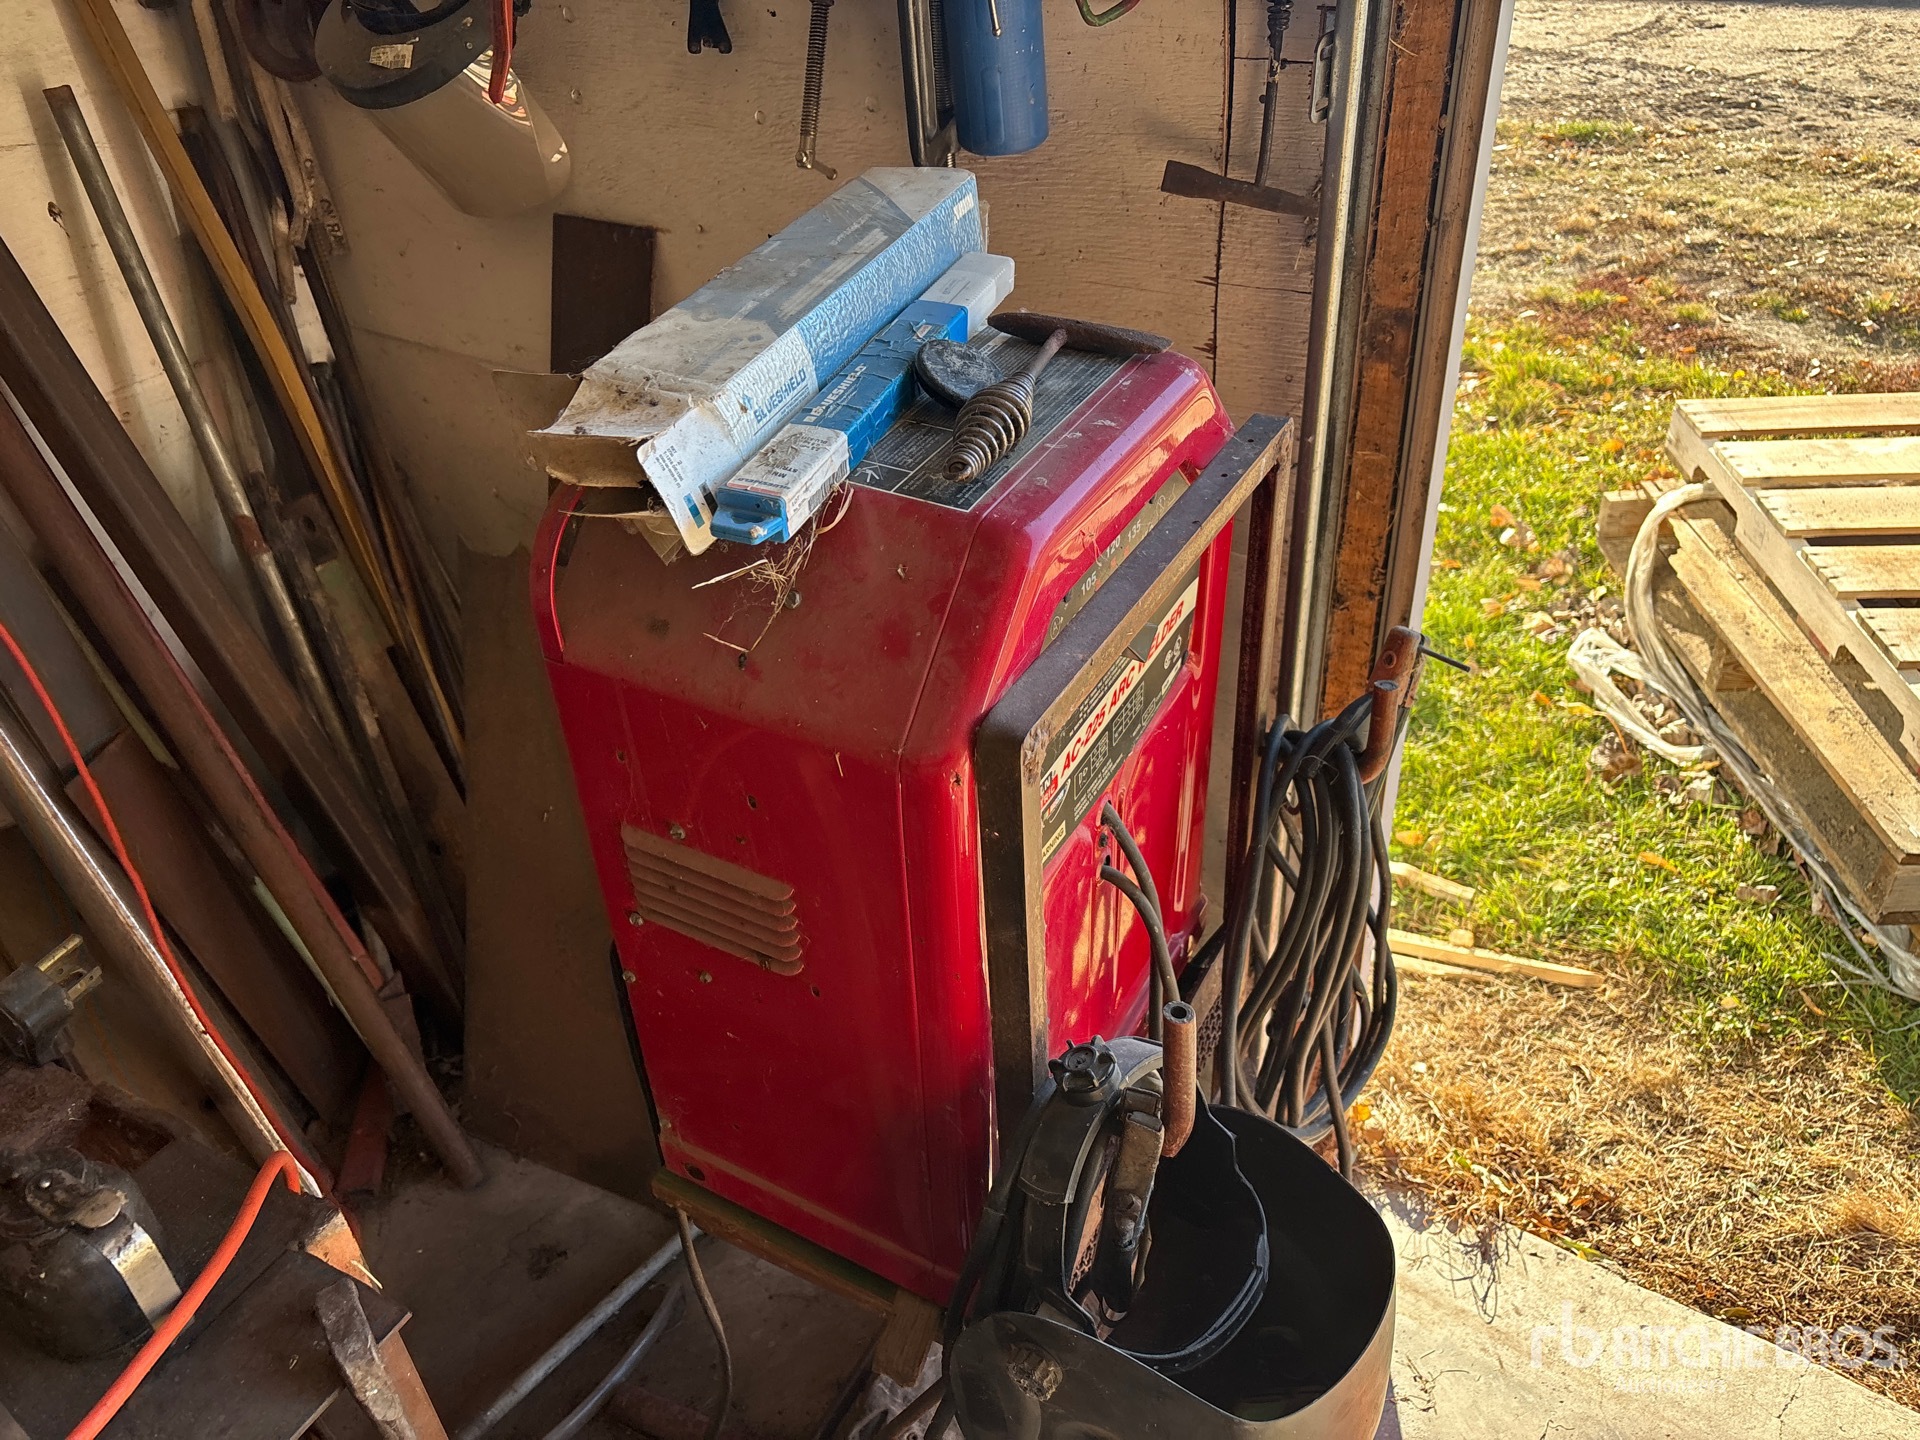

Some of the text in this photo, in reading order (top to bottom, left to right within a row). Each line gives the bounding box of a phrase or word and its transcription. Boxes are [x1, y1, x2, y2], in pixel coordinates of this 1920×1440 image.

[753, 367, 807, 424] BLUESHIELD
[1081, 519, 1142, 596] 105 120 135
[1061, 703, 1107, 778] AC-225
[1107, 665, 1135, 716] ARC
[1042, 827, 1066, 858] ARNING
